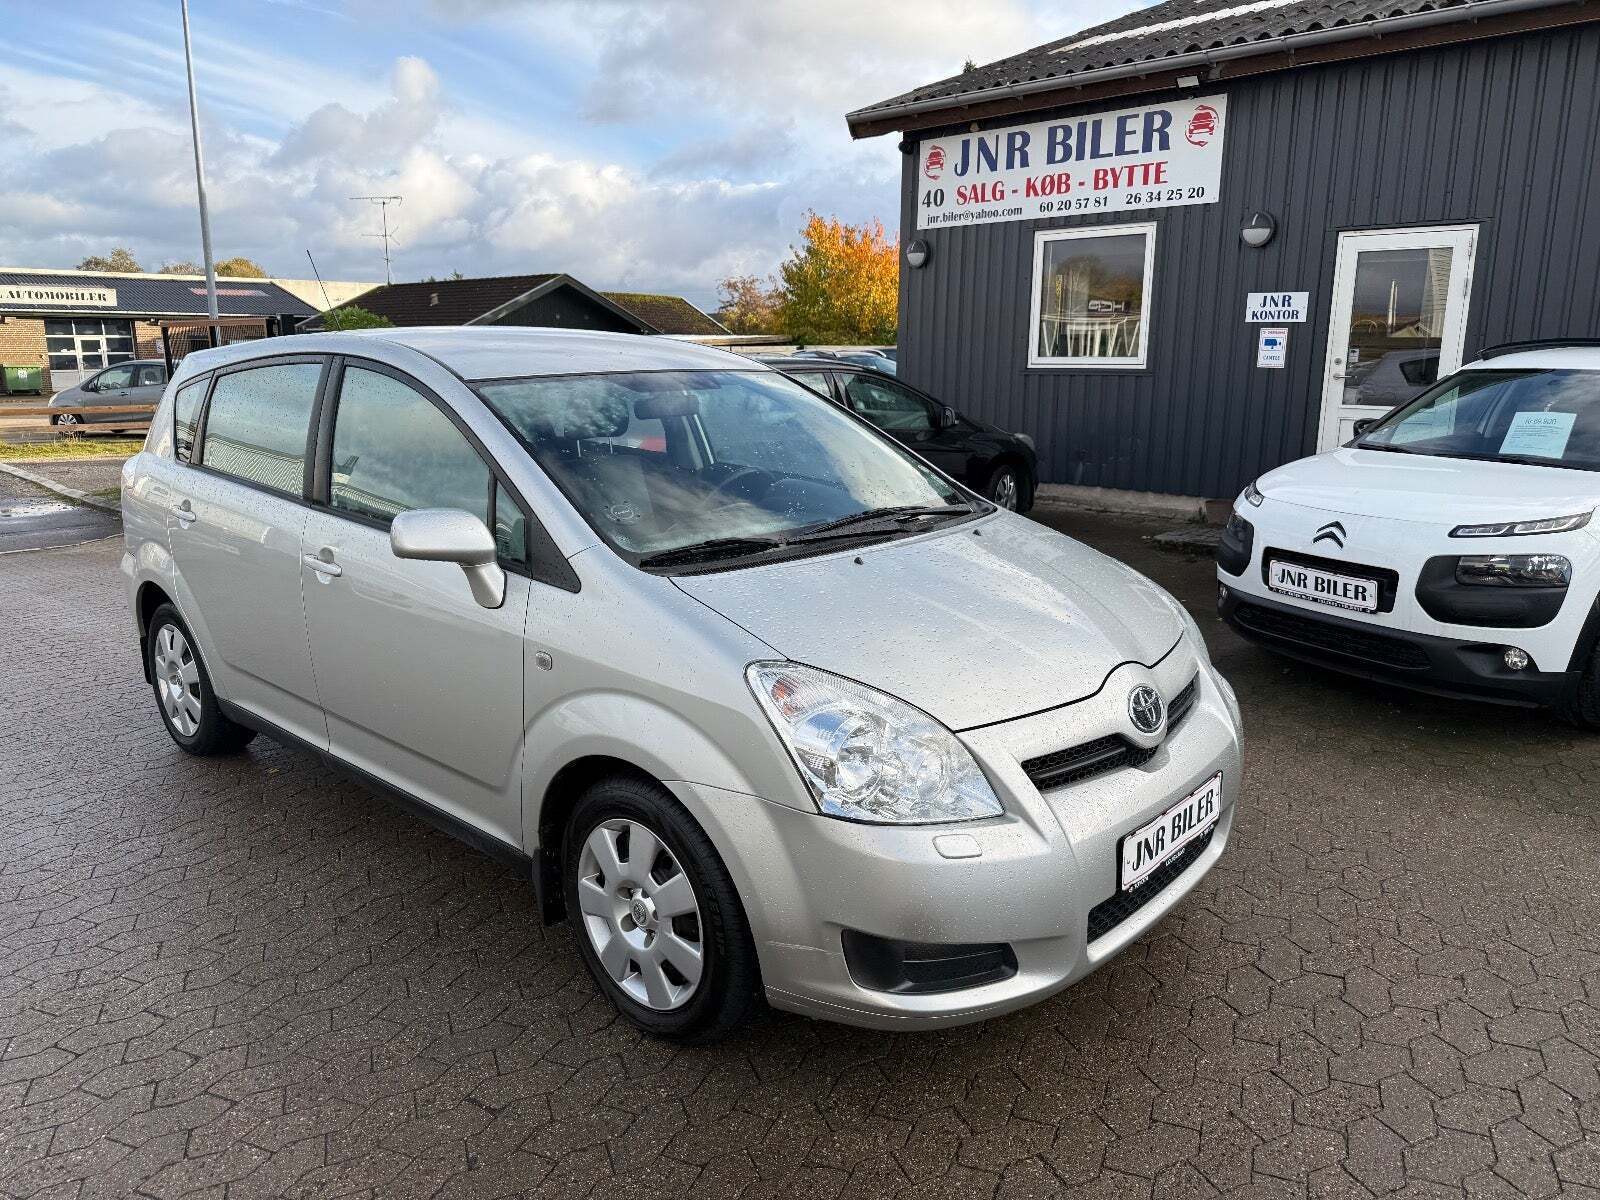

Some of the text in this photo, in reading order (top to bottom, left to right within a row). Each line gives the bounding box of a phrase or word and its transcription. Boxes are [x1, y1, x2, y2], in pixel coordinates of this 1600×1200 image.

[953, 109, 1173, 177] JNR BILER
[956, 181, 1005, 206] SALG
[1025, 172, 1071, 198] KØB
[1093, 161, 1169, 191] BYTTE
[921, 188, 945, 208] 40
[1039, 186, 1205, 213] 60 20 57 81 26 34 25 20
[927, 205, 1023, 226] jnr.biler@yahoo.com
[7, 290, 107, 302] AUTOMOBILER
[1259, 294, 1292, 308] JNR
[1251, 309, 1299, 321] KONTOR
[1277, 568, 1308, 589] JNR
[1314, 576, 1368, 602] BILER
[1132, 788, 1214, 871] JNR BILER
